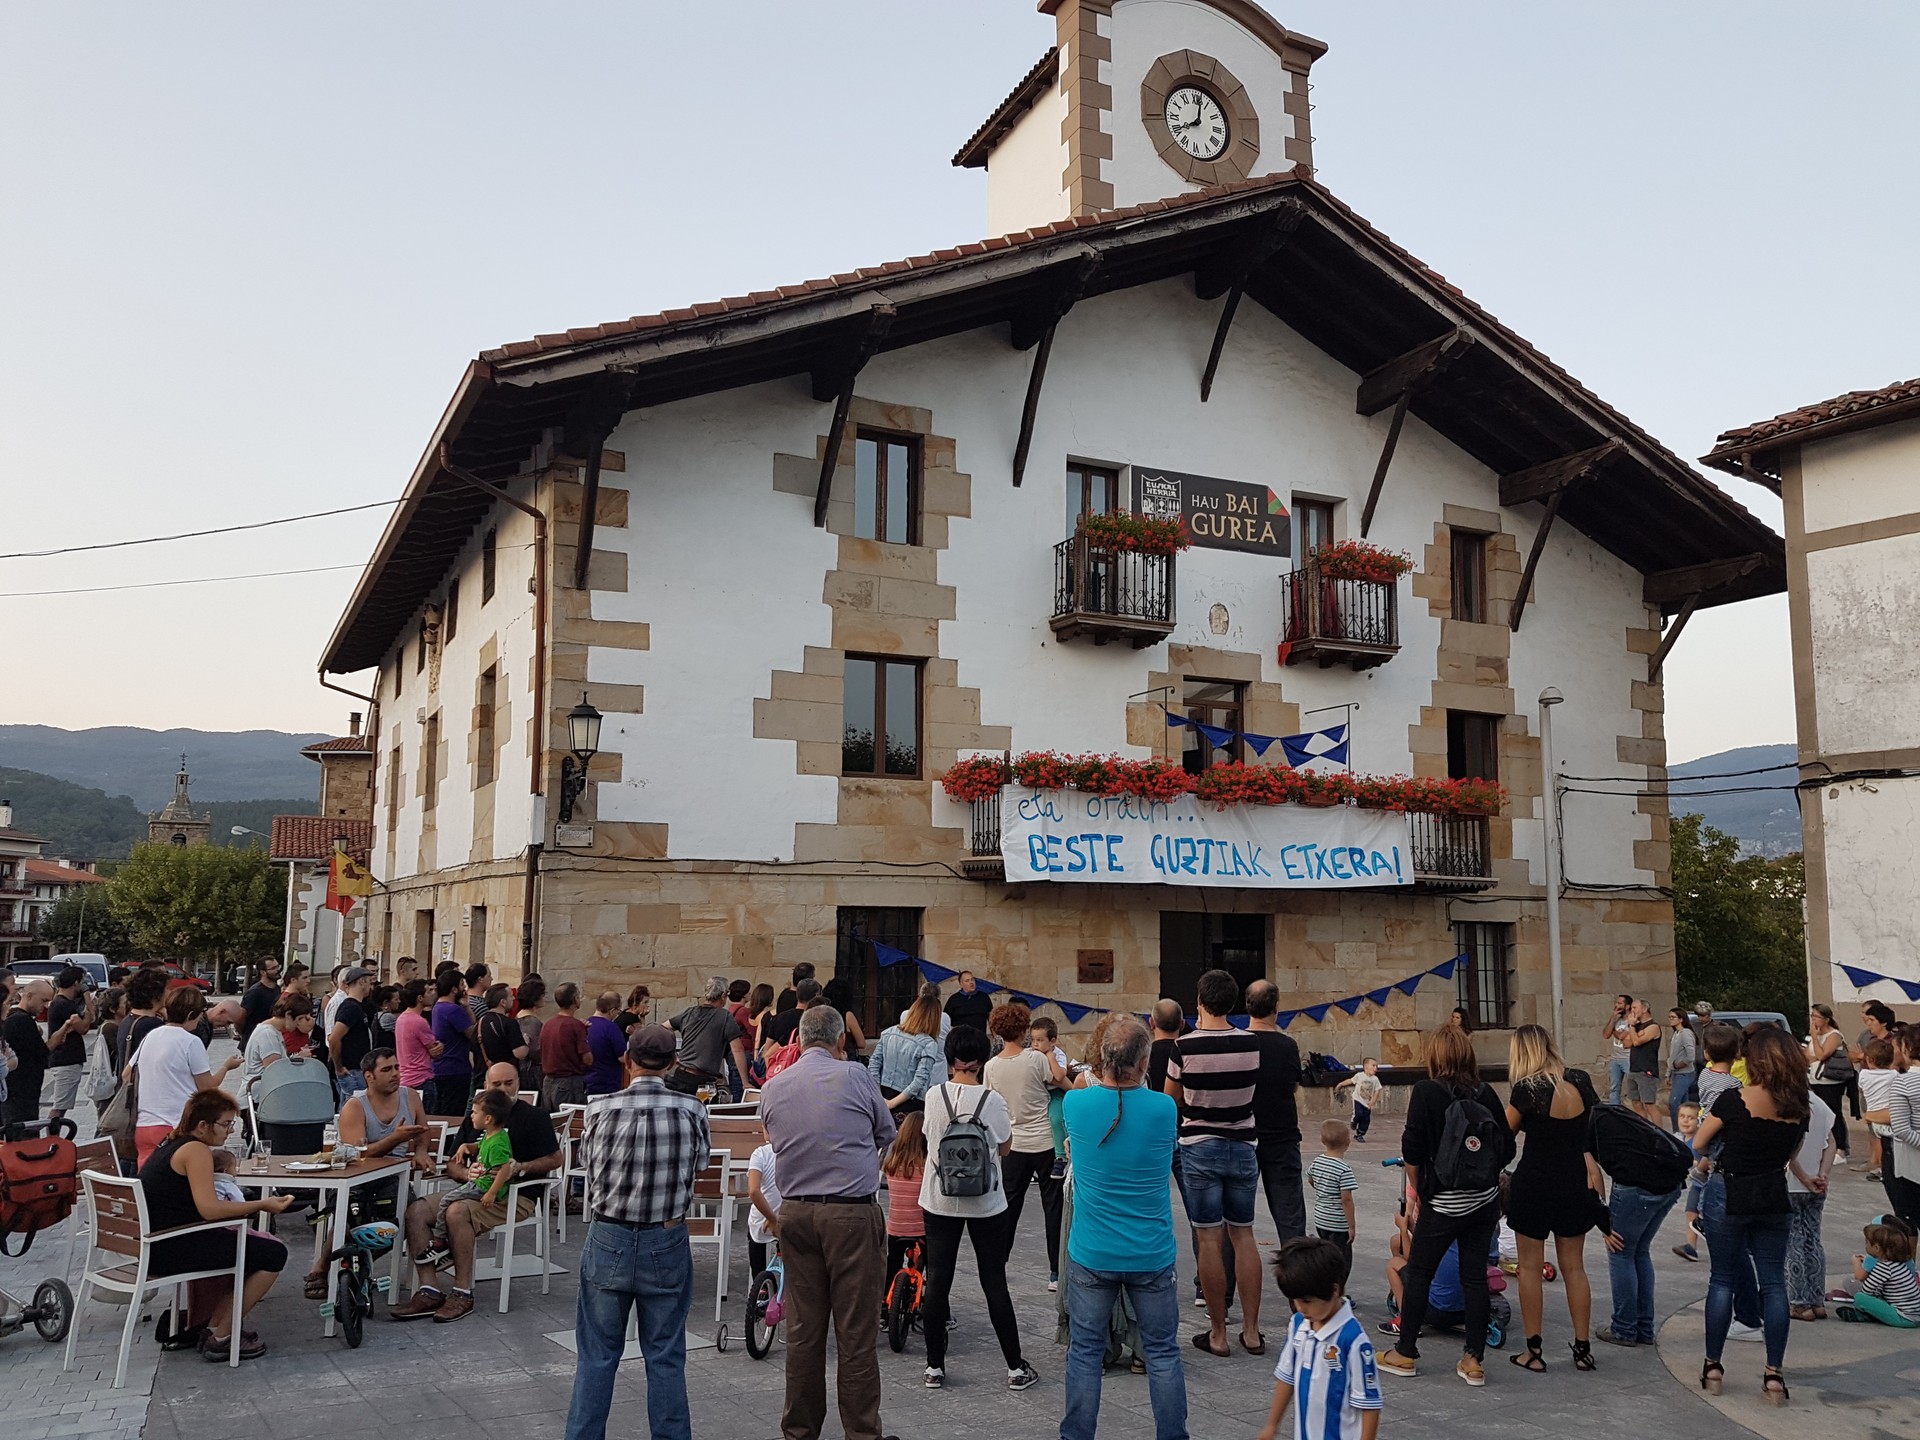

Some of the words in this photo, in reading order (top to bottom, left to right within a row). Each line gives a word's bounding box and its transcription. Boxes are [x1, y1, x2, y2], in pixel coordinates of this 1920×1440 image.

[1145, 481, 1177, 491] EUSKAL
[1146, 488, 1177, 497] HERRIA
[1191, 494, 1219, 510] HAU
[1225, 493, 1259, 516] BAI
[1191, 512, 1278, 545] GUREA
[1018, 788, 1063, 822] eta
[1027, 834, 1125, 874] BESTE
[1150, 834, 1271, 878] GUZTIAK
[1280, 843, 1404, 884] ETXERA!
